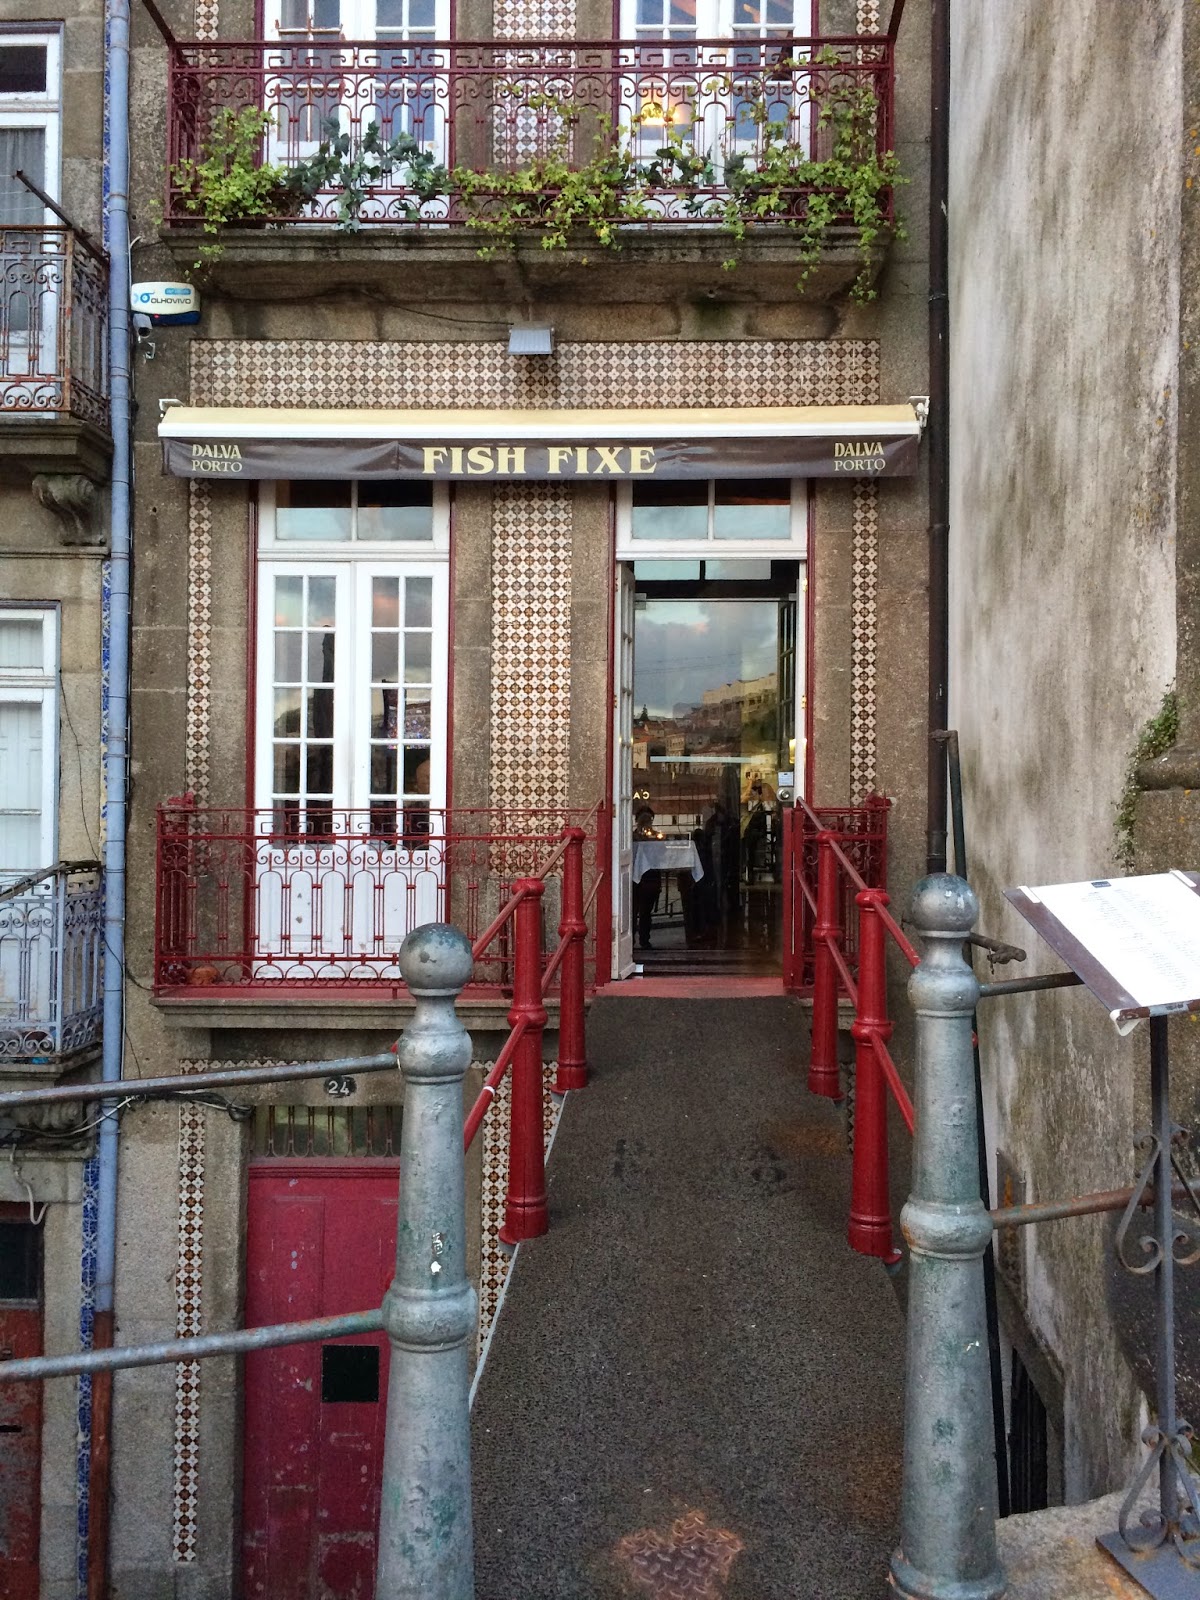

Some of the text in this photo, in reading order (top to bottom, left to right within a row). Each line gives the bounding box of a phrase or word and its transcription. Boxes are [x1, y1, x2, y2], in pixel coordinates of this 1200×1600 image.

[191, 444, 243, 459] DALVA
[834, 441, 885, 458] DALVA
[191, 459, 243, 473] PORTO
[422, 446, 657, 475] FISH FIXE
[834, 458, 886, 472] PORTO
[328, 1080, 350, 1095] 24
